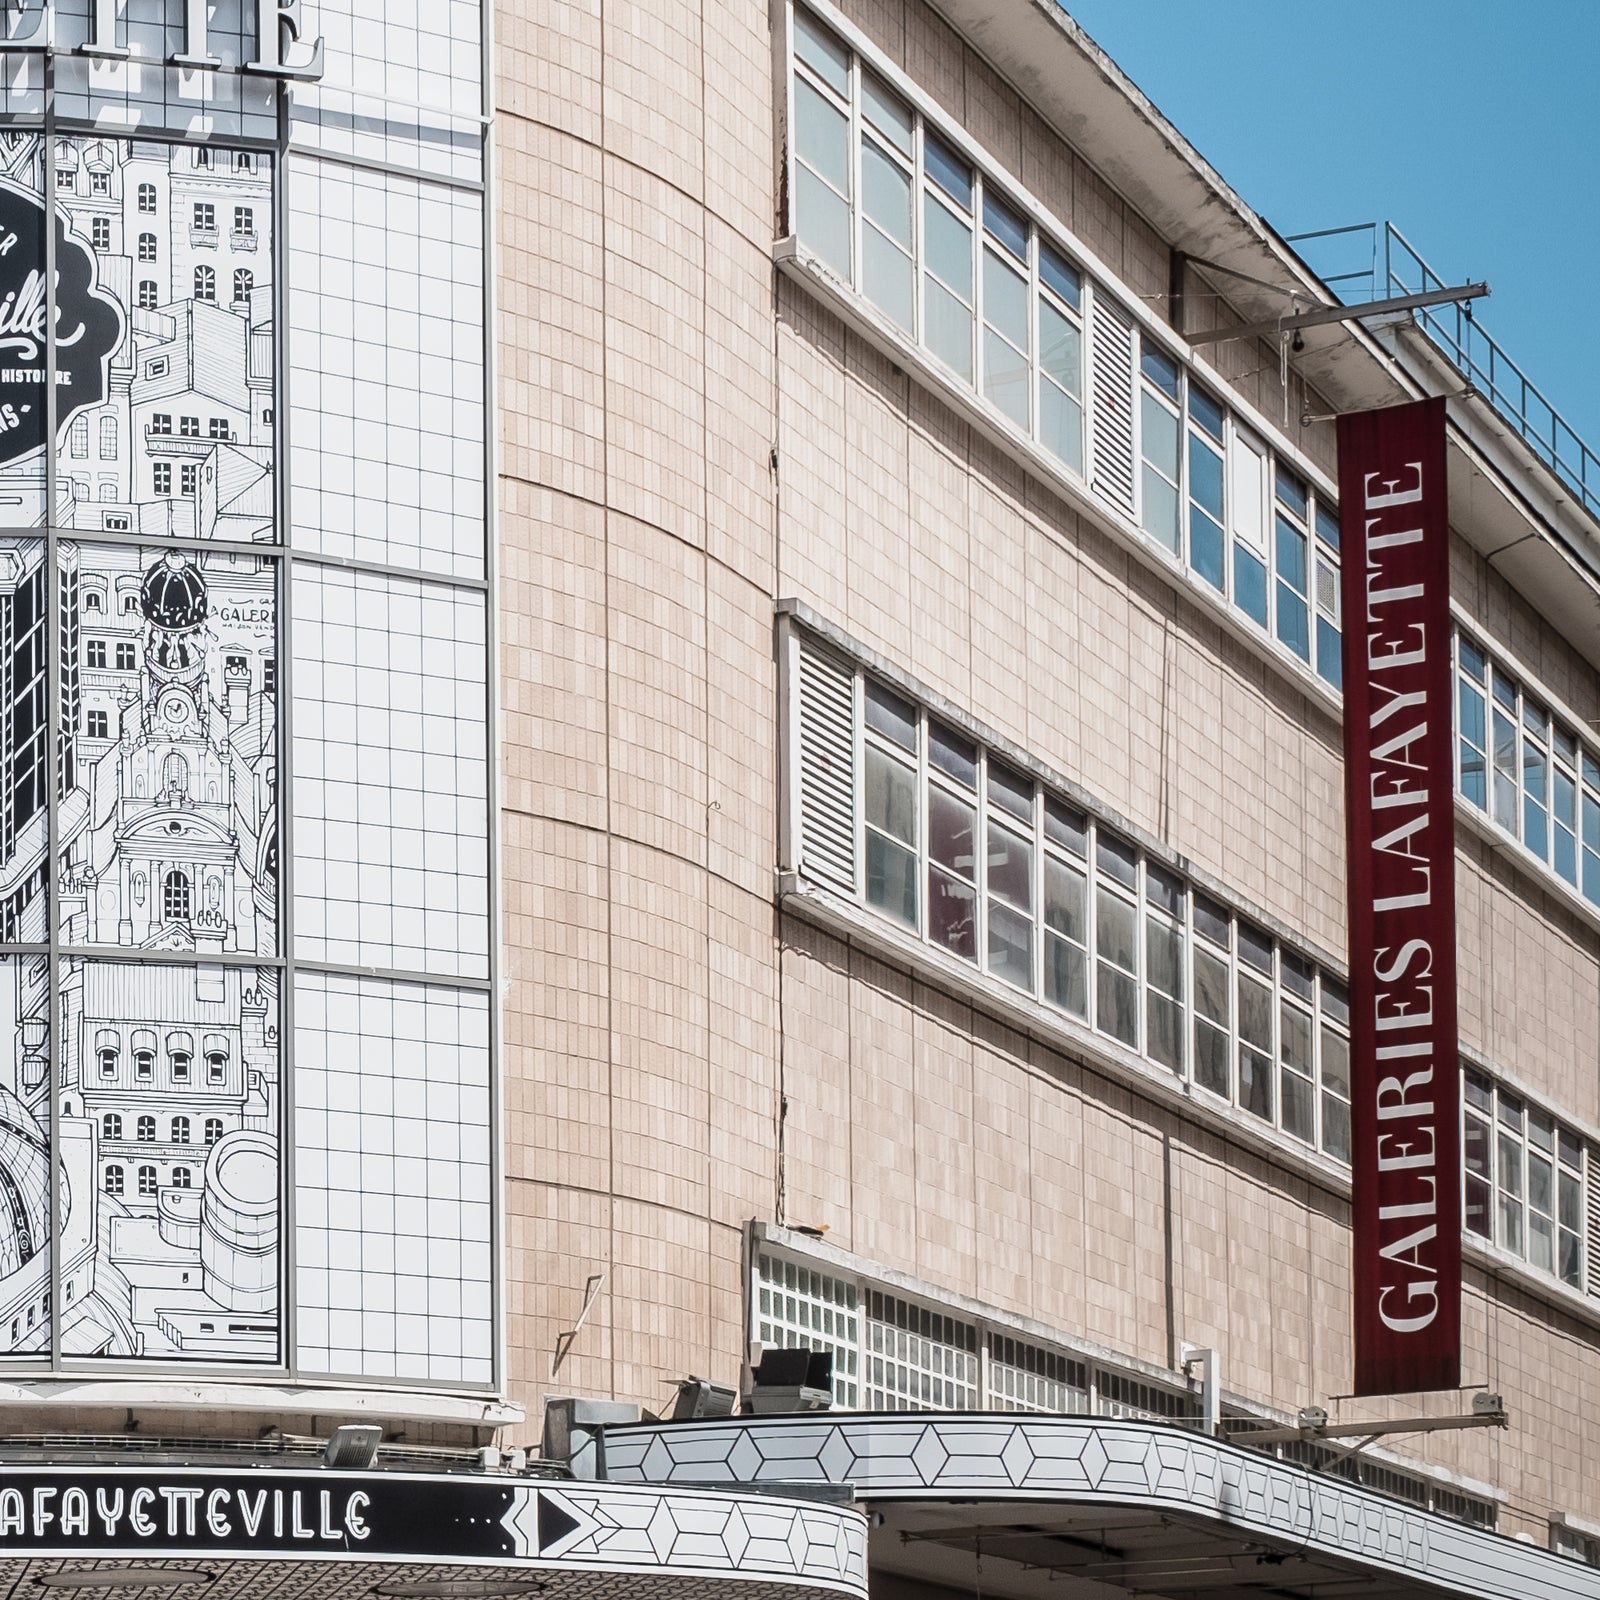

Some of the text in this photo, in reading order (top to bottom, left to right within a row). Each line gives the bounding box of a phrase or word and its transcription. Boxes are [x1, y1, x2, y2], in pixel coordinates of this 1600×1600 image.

[1, 368, 73, 386] HISTOIRE
[1364, 460, 1440, 1333] GALERIES LAFAYETTE
